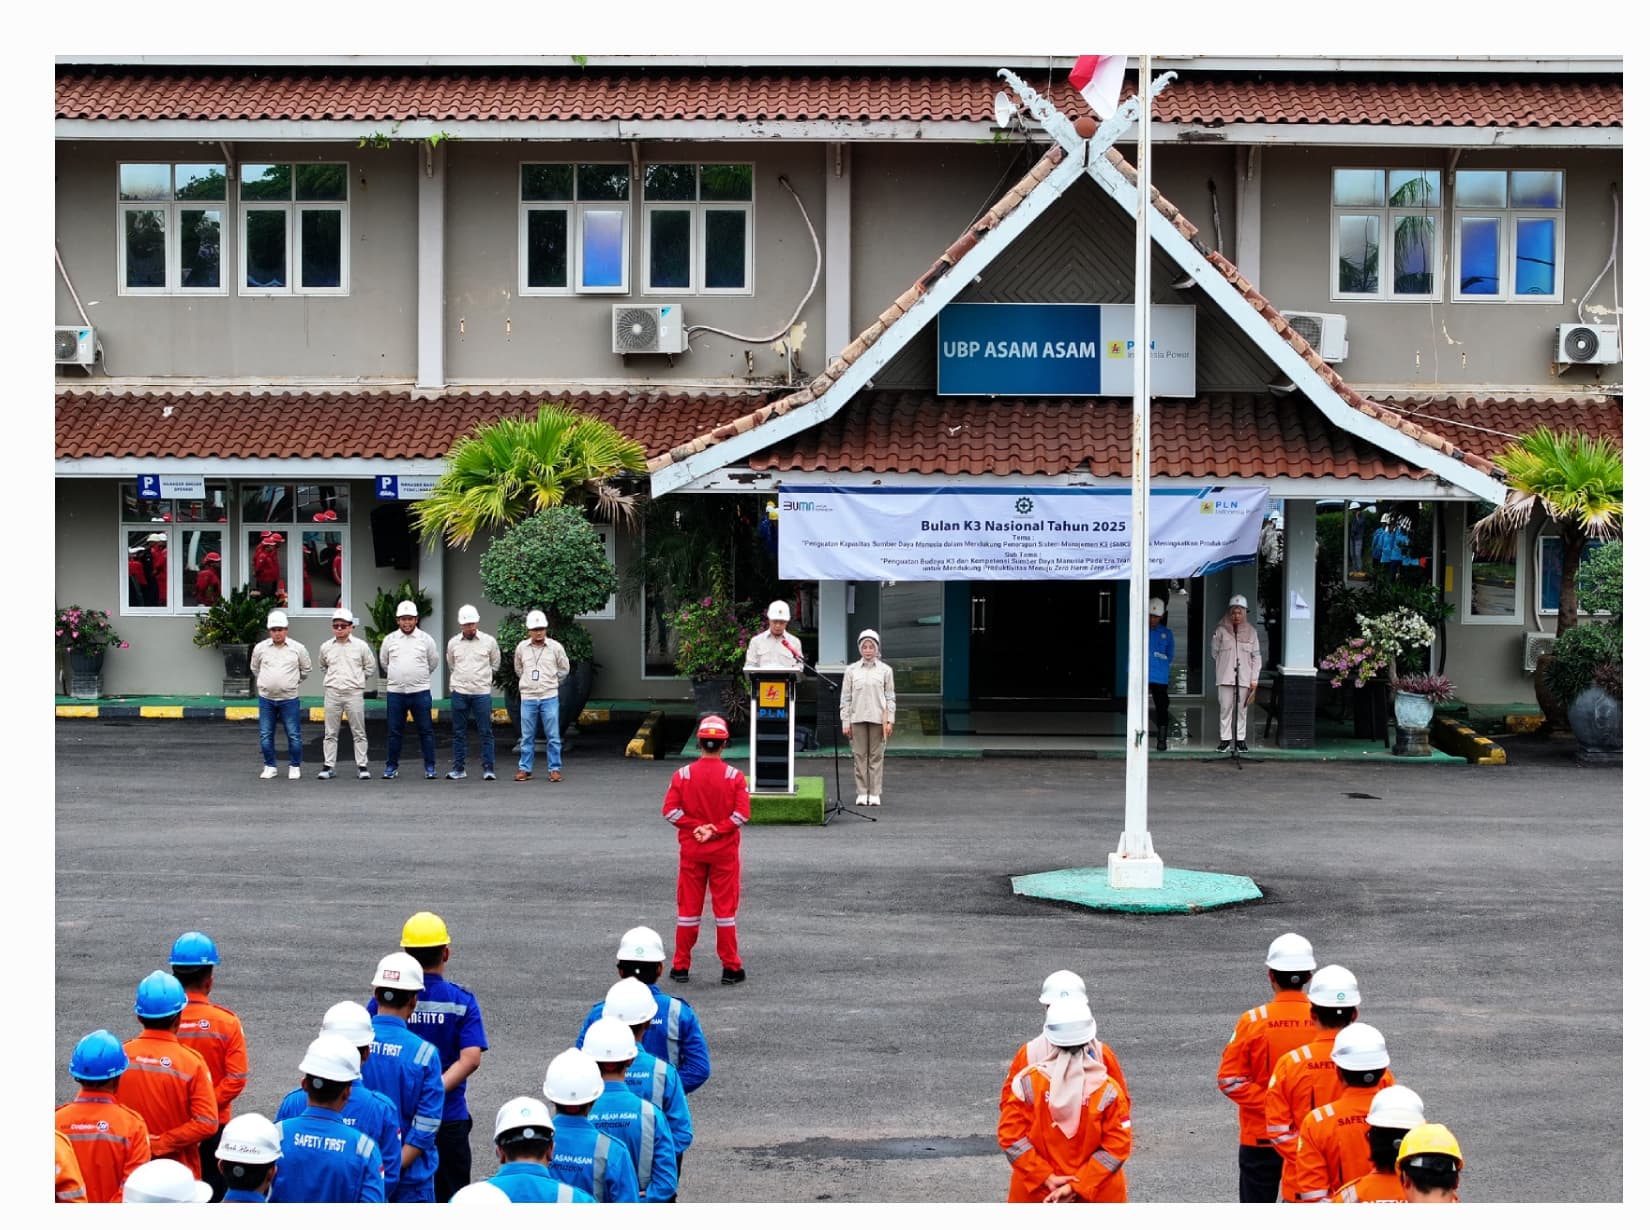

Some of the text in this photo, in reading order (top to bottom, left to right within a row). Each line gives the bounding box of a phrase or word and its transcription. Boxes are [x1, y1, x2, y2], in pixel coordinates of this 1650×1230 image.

[943, 341, 1096, 359] UBP ASAM ASAM
[1127, 341, 1155, 350] PN
[144, 477, 153, 489] P
[382, 477, 392, 489] P
[1216, 501, 1239, 509] PLN
[921, 520, 1126, 533] Bulan K3 Nasional Tahun 2025
[759, 709, 785, 718] PLN
[1268, 1020, 1299, 1028] SAFETY
[383, 1043, 402, 1056] FIRST
[1308, 1061, 1336, 1069] SAFET
[1338, 1116, 1368, 1126] SAFET
[294, 1133, 346, 1152] SAFETY FIRST
